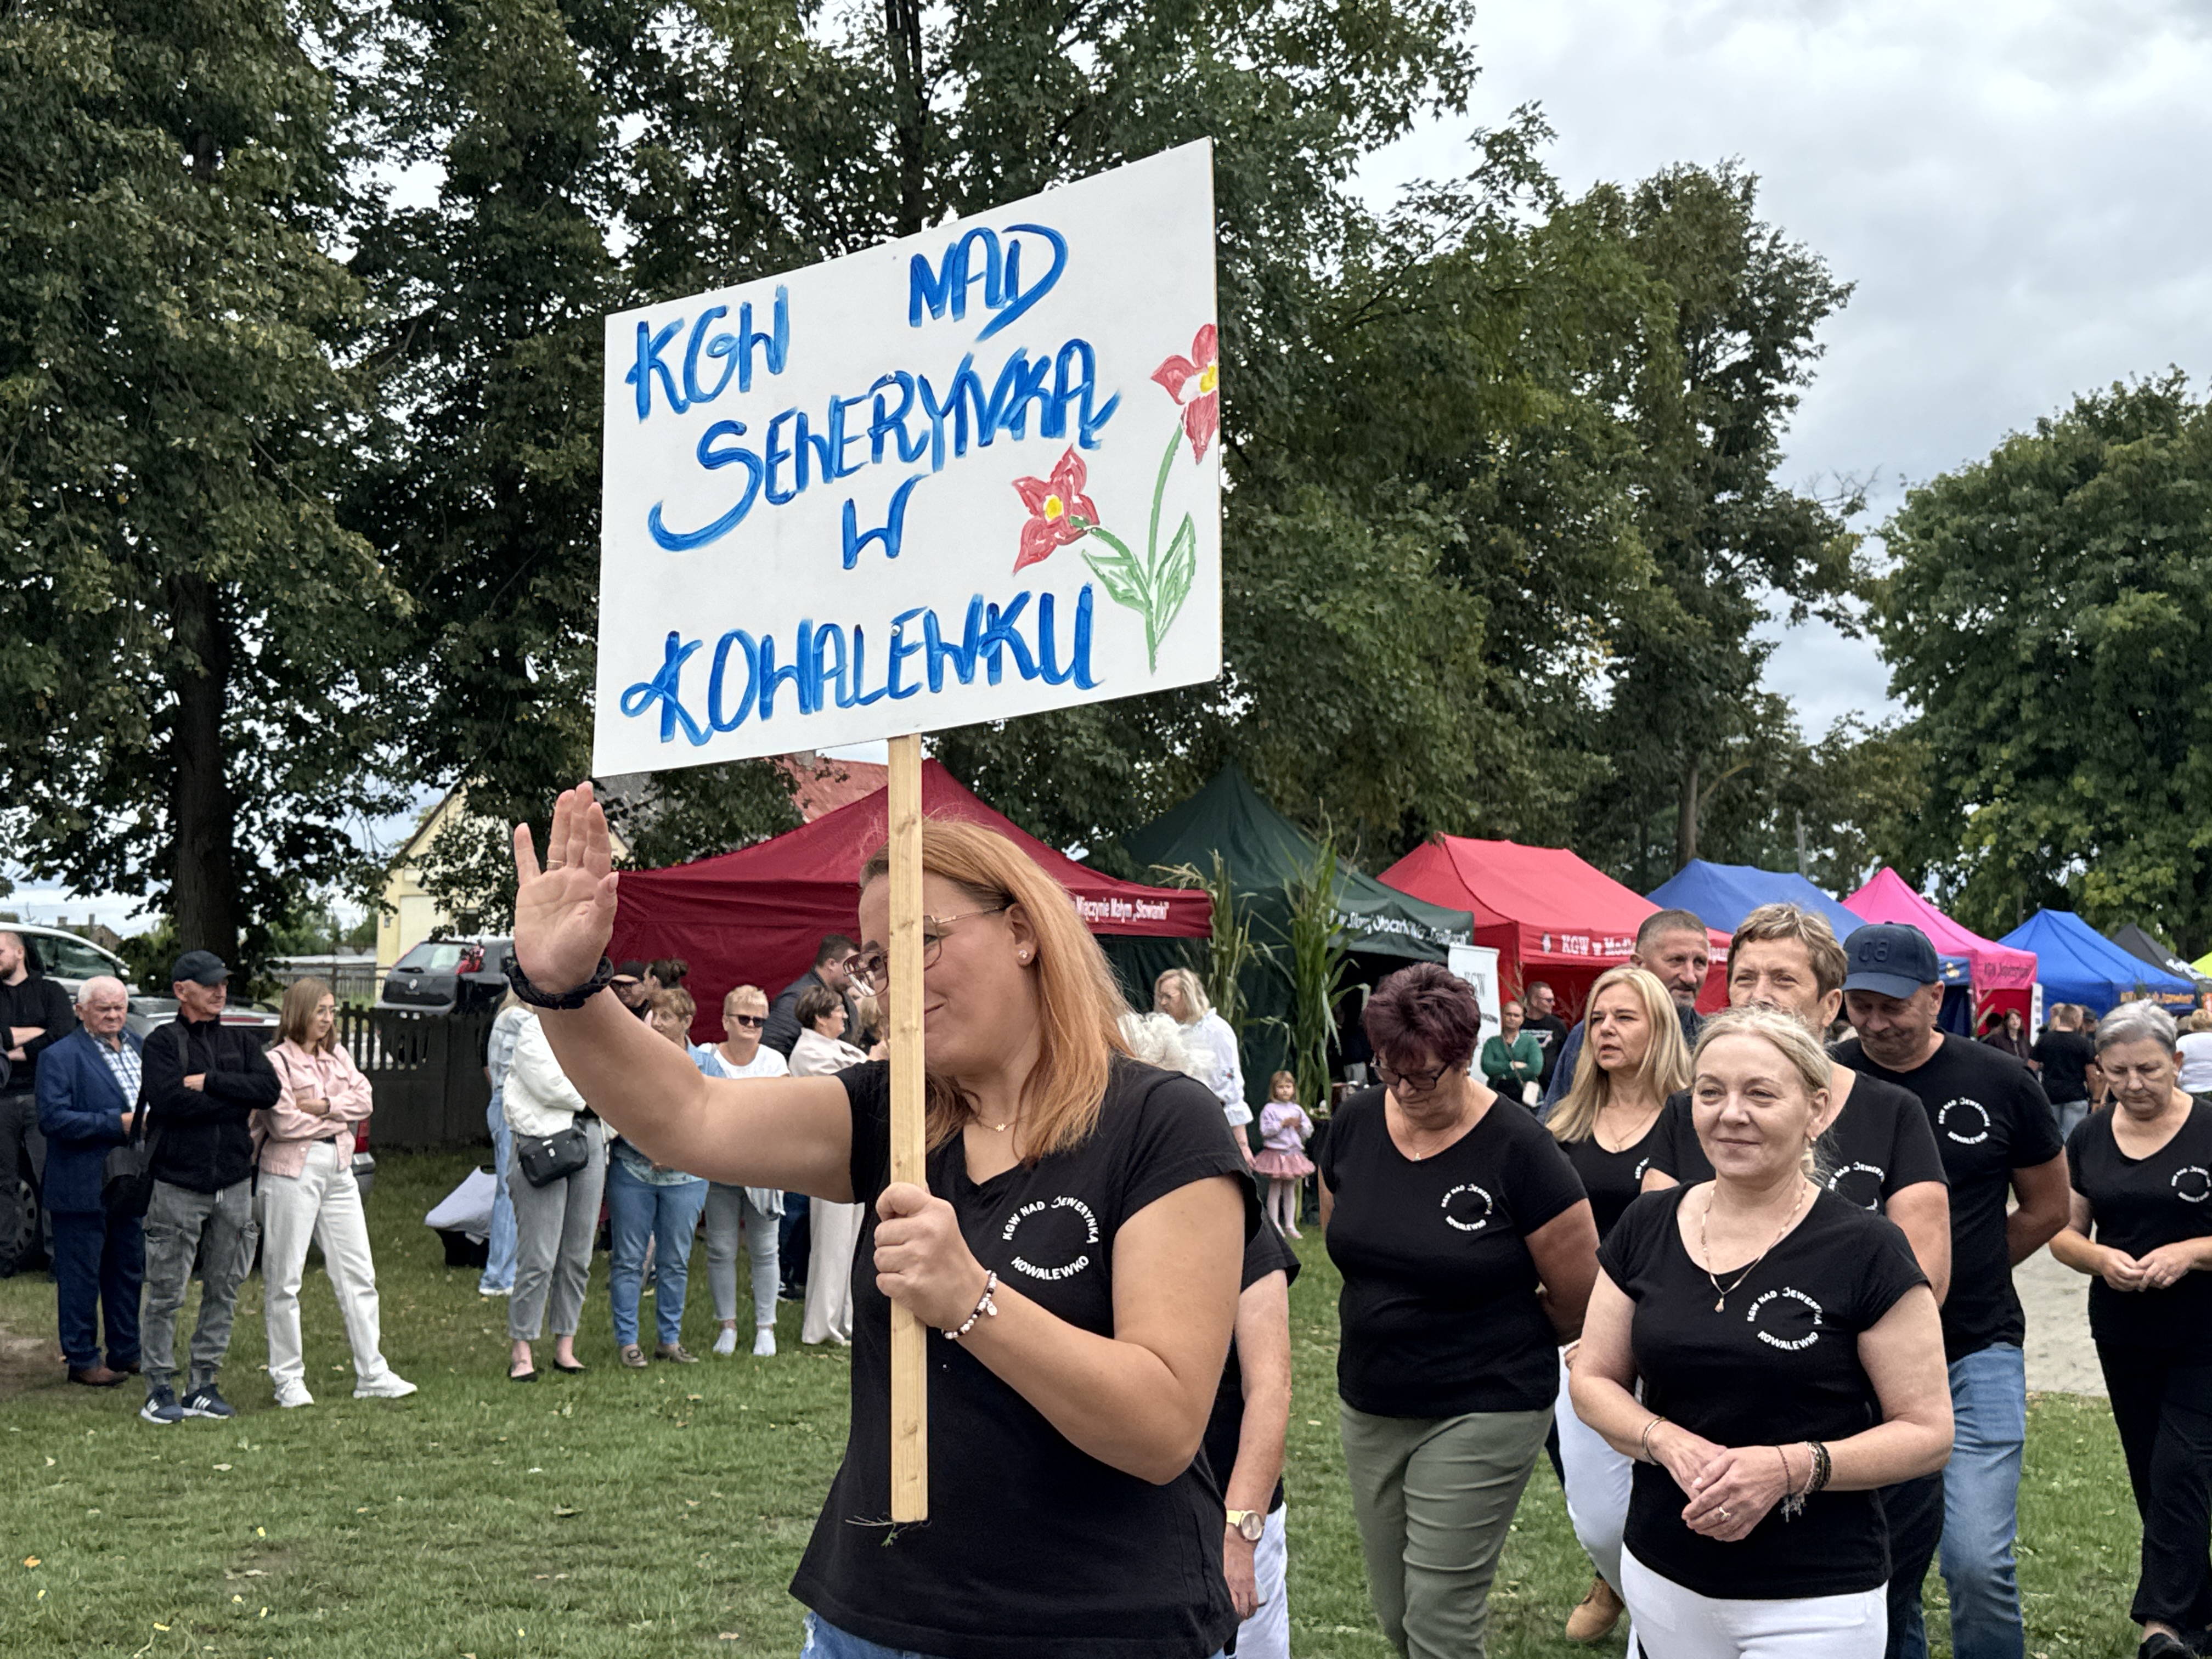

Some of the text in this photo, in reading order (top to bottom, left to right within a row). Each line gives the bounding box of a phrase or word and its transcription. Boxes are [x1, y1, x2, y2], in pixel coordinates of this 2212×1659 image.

[625, 223, 1068, 421] KGW NAD
[842, 473, 930, 569] W
[620, 582, 1105, 746] KOWALEWKU
[1561, 935, 1589, 956] KGW
[1002, 1213, 1021, 1241] KGW
[1019, 1201, 1046, 1217] NAD
[1011, 1255, 1090, 1280] KOWALEWKO
[1747, 1302, 1760, 1322] KGW
[1758, 1290, 1778, 1304] NAD
[1757, 1330, 1819, 1350] KOWALEWKO
